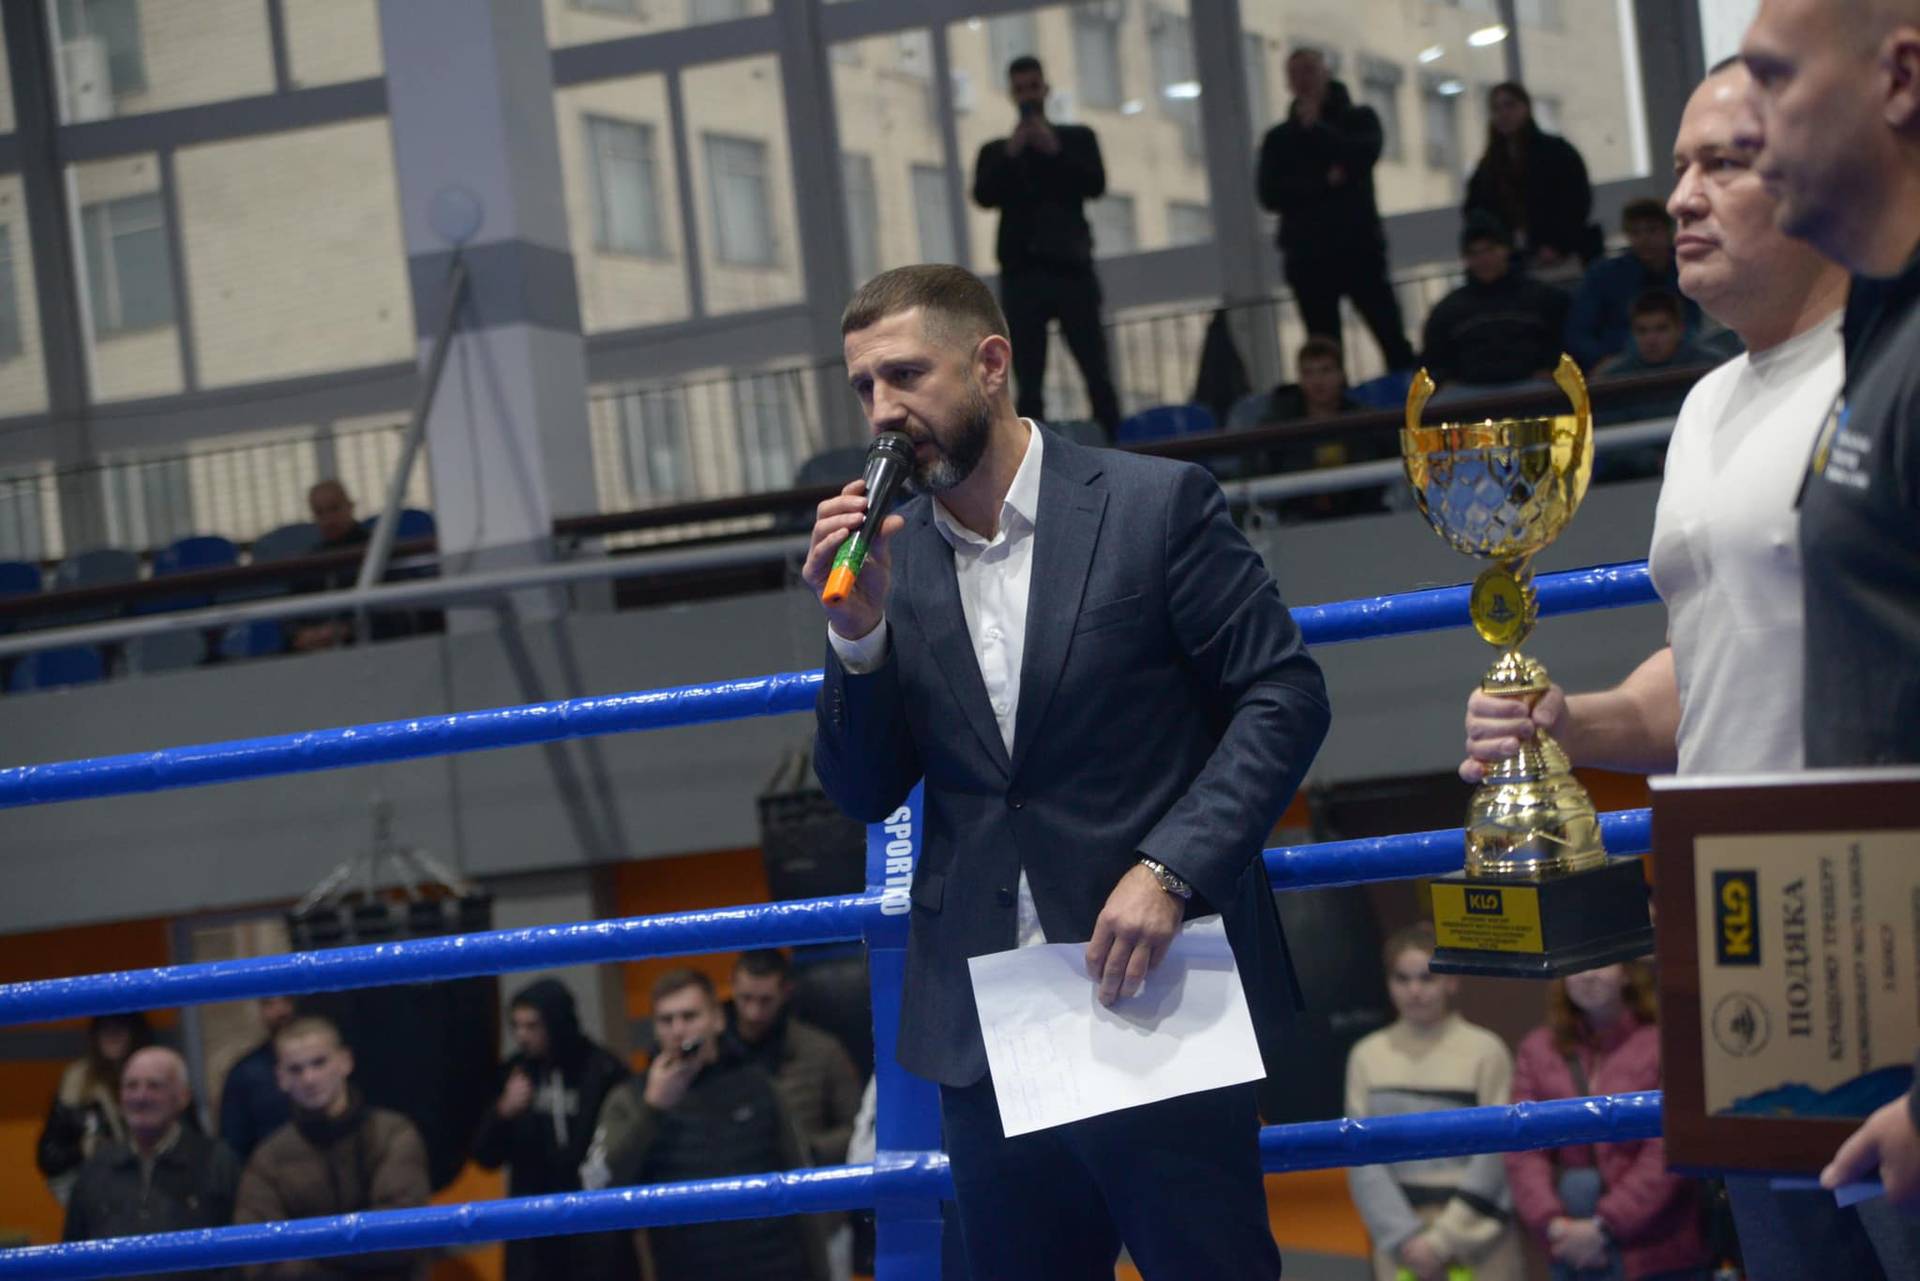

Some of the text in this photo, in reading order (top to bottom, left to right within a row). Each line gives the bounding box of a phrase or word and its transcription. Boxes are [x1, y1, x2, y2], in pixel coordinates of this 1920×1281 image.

[1470, 895, 1498, 910] KLO
[1722, 879, 1753, 956] KLO
[1781, 878, 1813, 1037] ПОДЯКА
